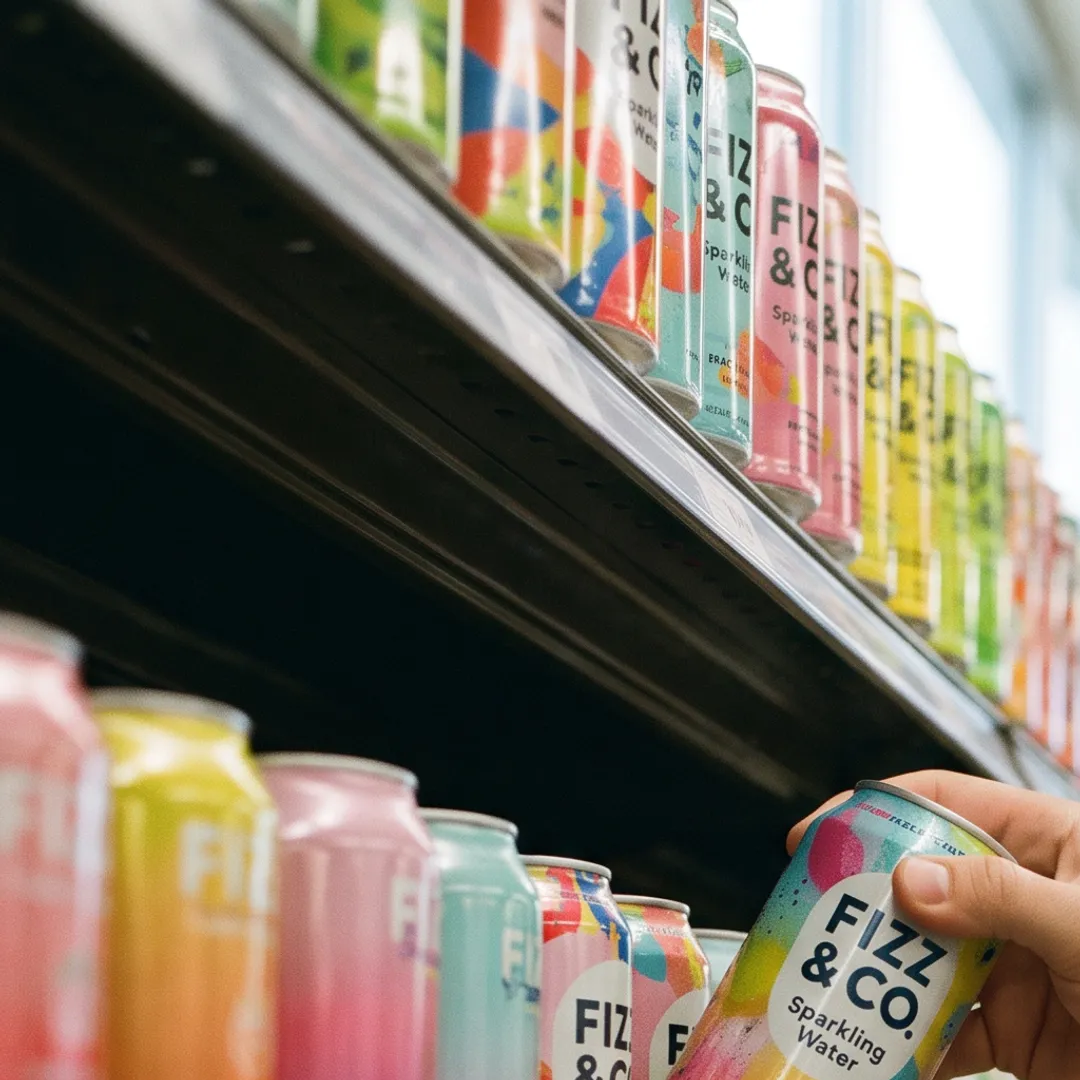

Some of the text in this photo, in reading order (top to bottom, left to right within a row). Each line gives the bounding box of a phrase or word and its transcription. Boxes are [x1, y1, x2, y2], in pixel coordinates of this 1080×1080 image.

[769, 246, 796, 289] &
[825, 893, 949, 989] FIZZ
[801, 941, 919, 1041] & CO.
[575, 998, 632, 1052] FIZ
[788, 996, 887, 1066] Sparkling
[797, 1024, 859, 1071] Water
